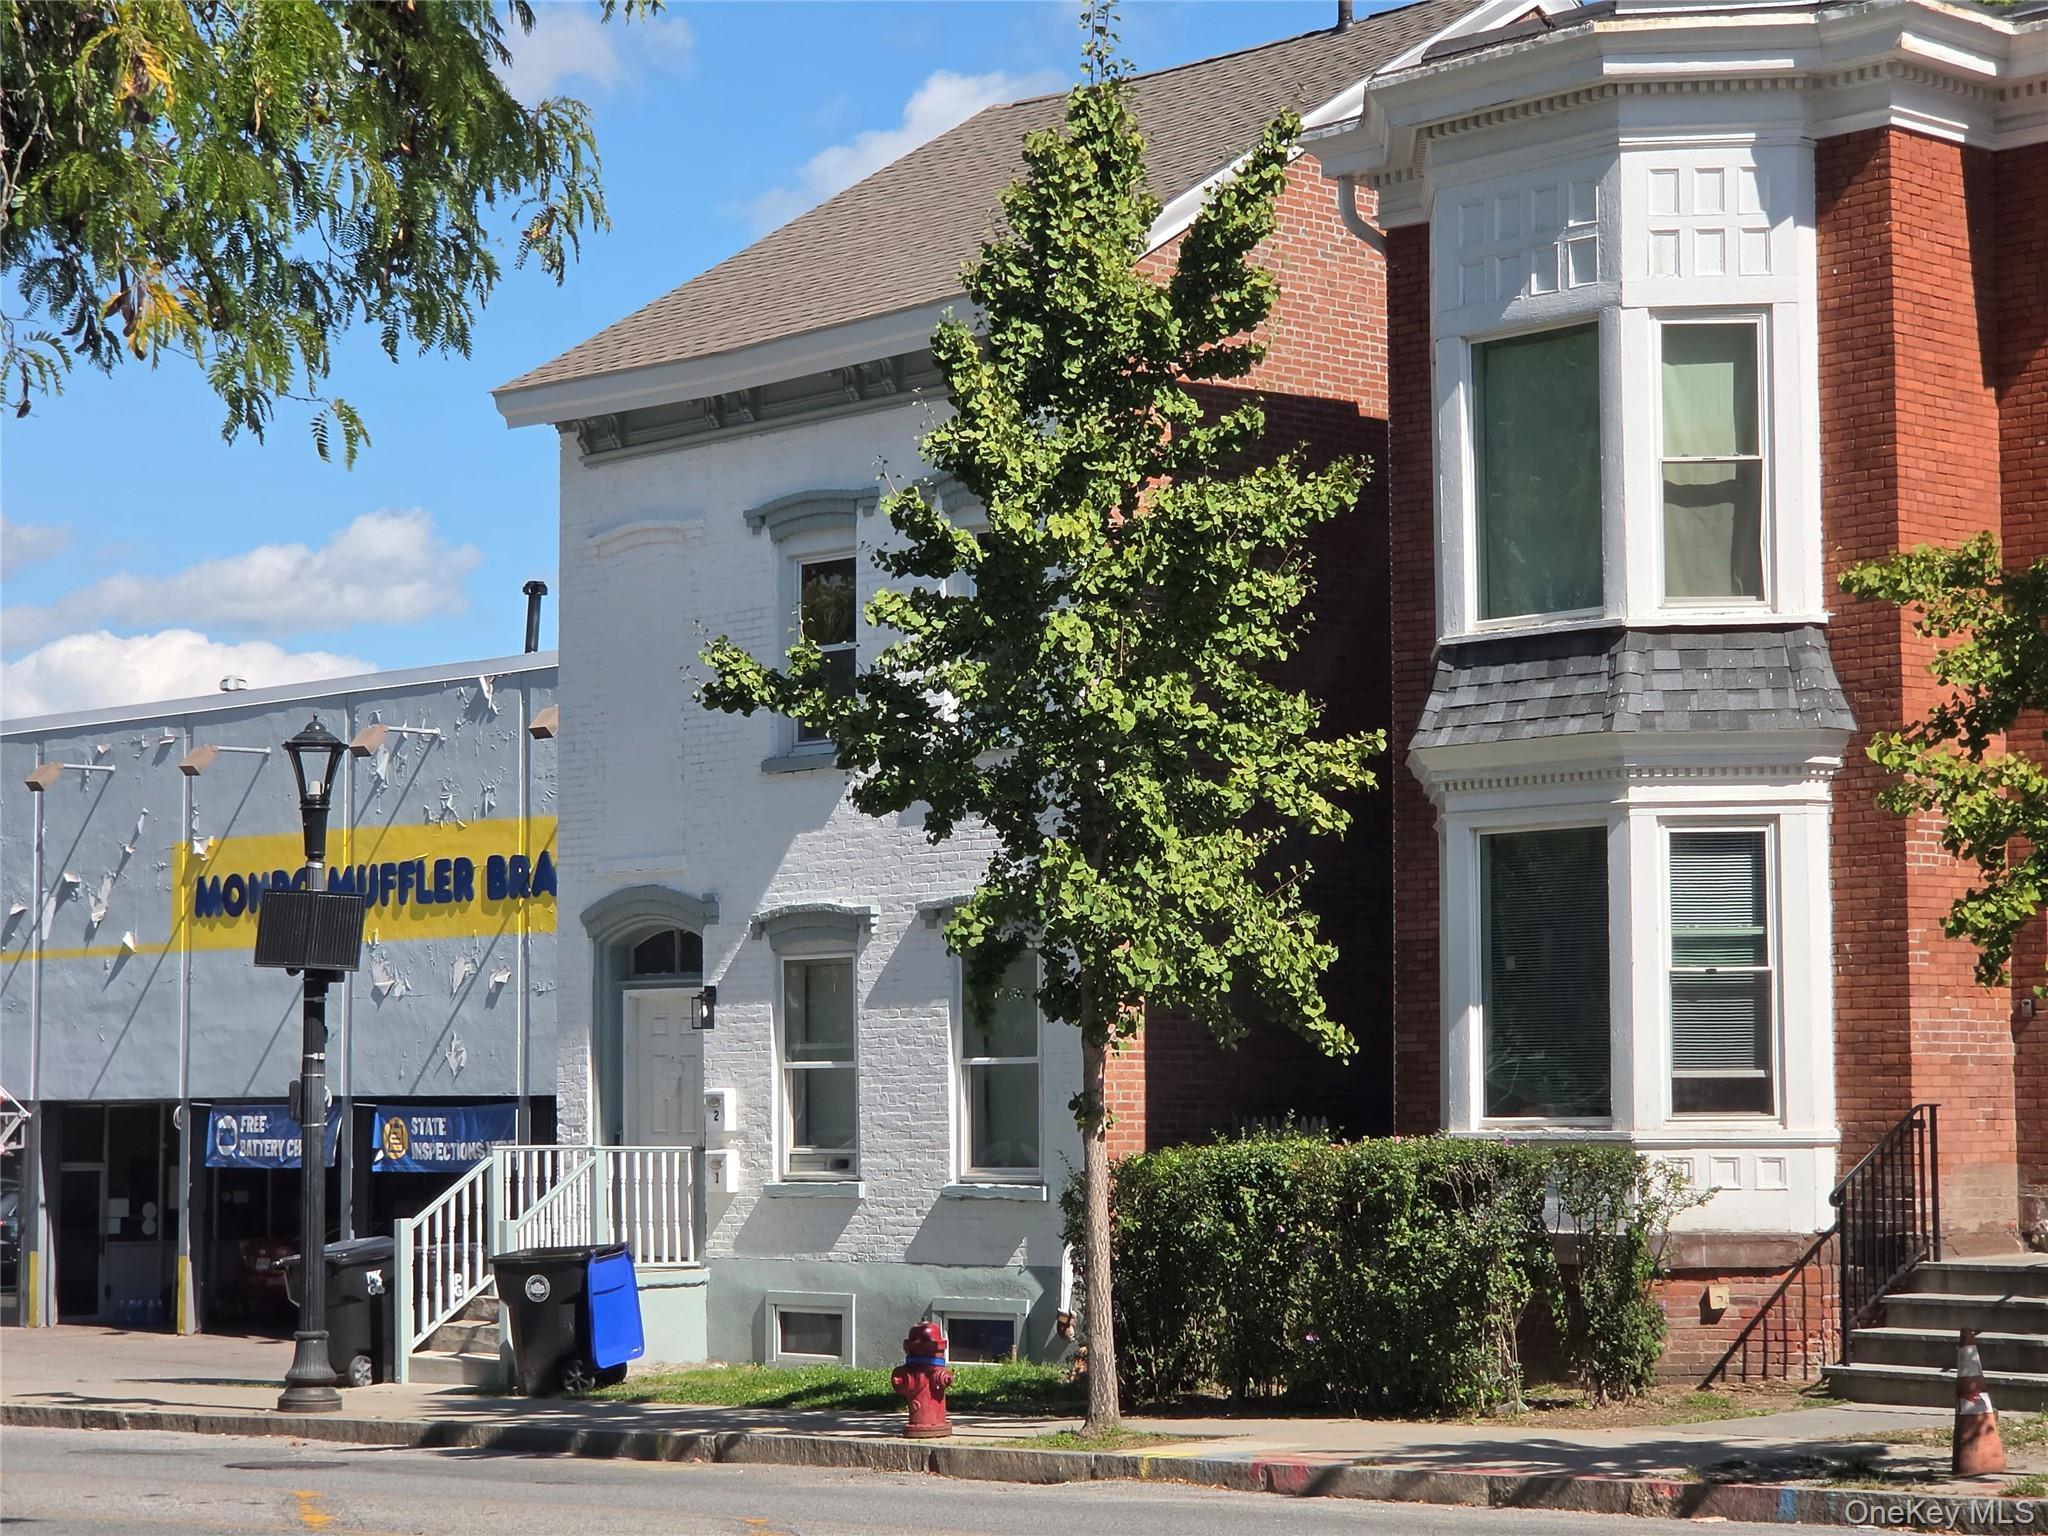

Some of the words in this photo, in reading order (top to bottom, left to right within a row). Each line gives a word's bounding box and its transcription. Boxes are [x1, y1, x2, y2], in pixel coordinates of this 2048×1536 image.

[194, 868, 307, 918] MON
[327, 857, 475, 906] MUFFLER
[240, 1115, 267, 1133] FREE
[714, 1110, 719, 1121] 2
[411, 1117, 447, 1136] STATE
[239, 1139, 285, 1158] BATTERY
[411, 1141, 486, 1161] INSPECTIONS
[715, 1173, 719, 1183] 1
